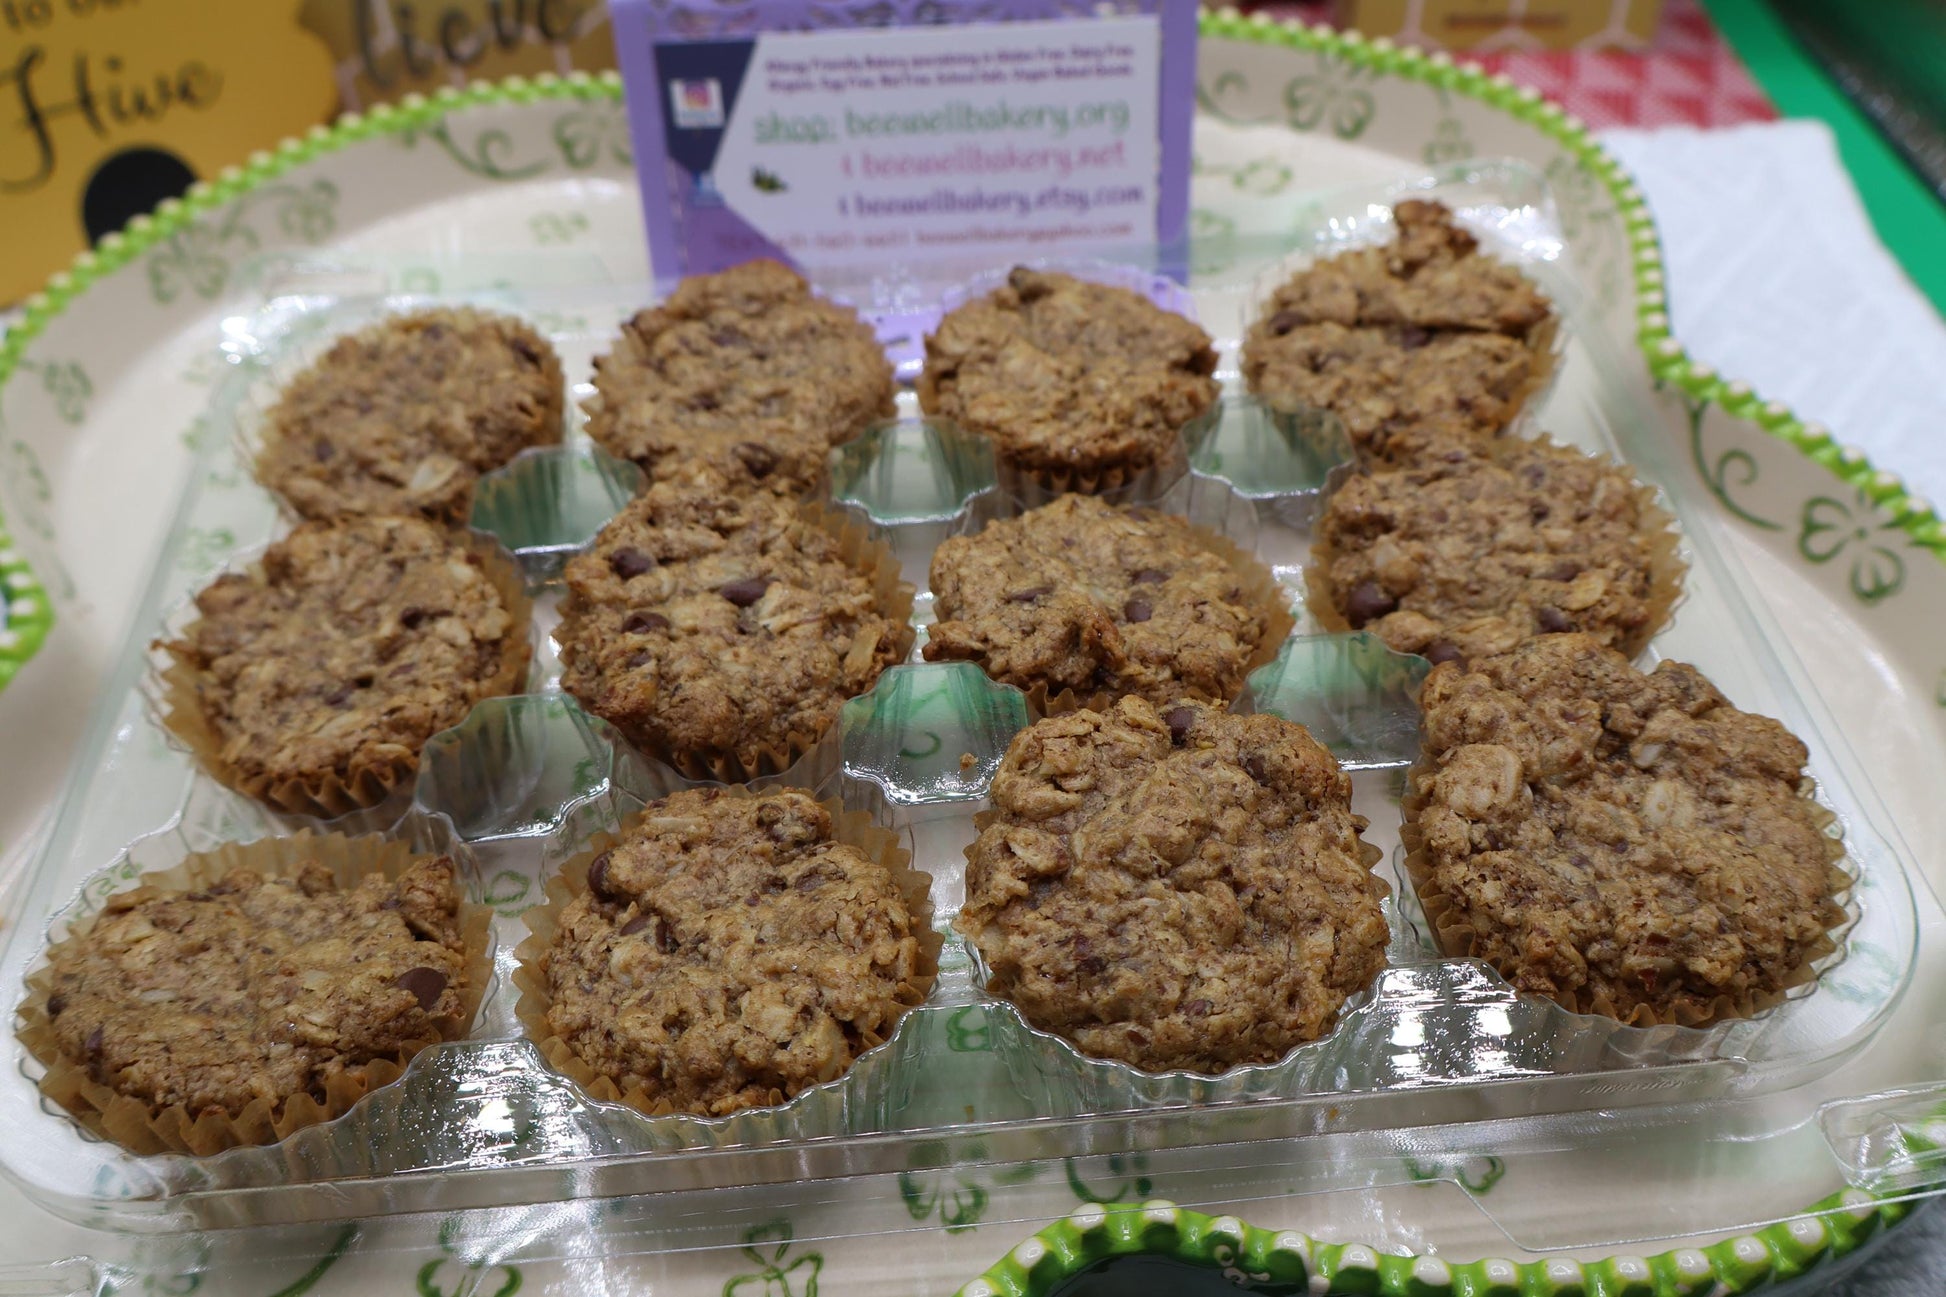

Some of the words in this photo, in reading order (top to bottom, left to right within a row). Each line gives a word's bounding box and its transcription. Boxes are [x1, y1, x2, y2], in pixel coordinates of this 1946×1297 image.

[0, 44, 225, 192] Hive
[844, 98, 1130, 140] beewellbakery.org
[861, 138, 1124, 182] beewellbakery.net
[854, 183, 1143, 221] beewellbakery.etsy.com
